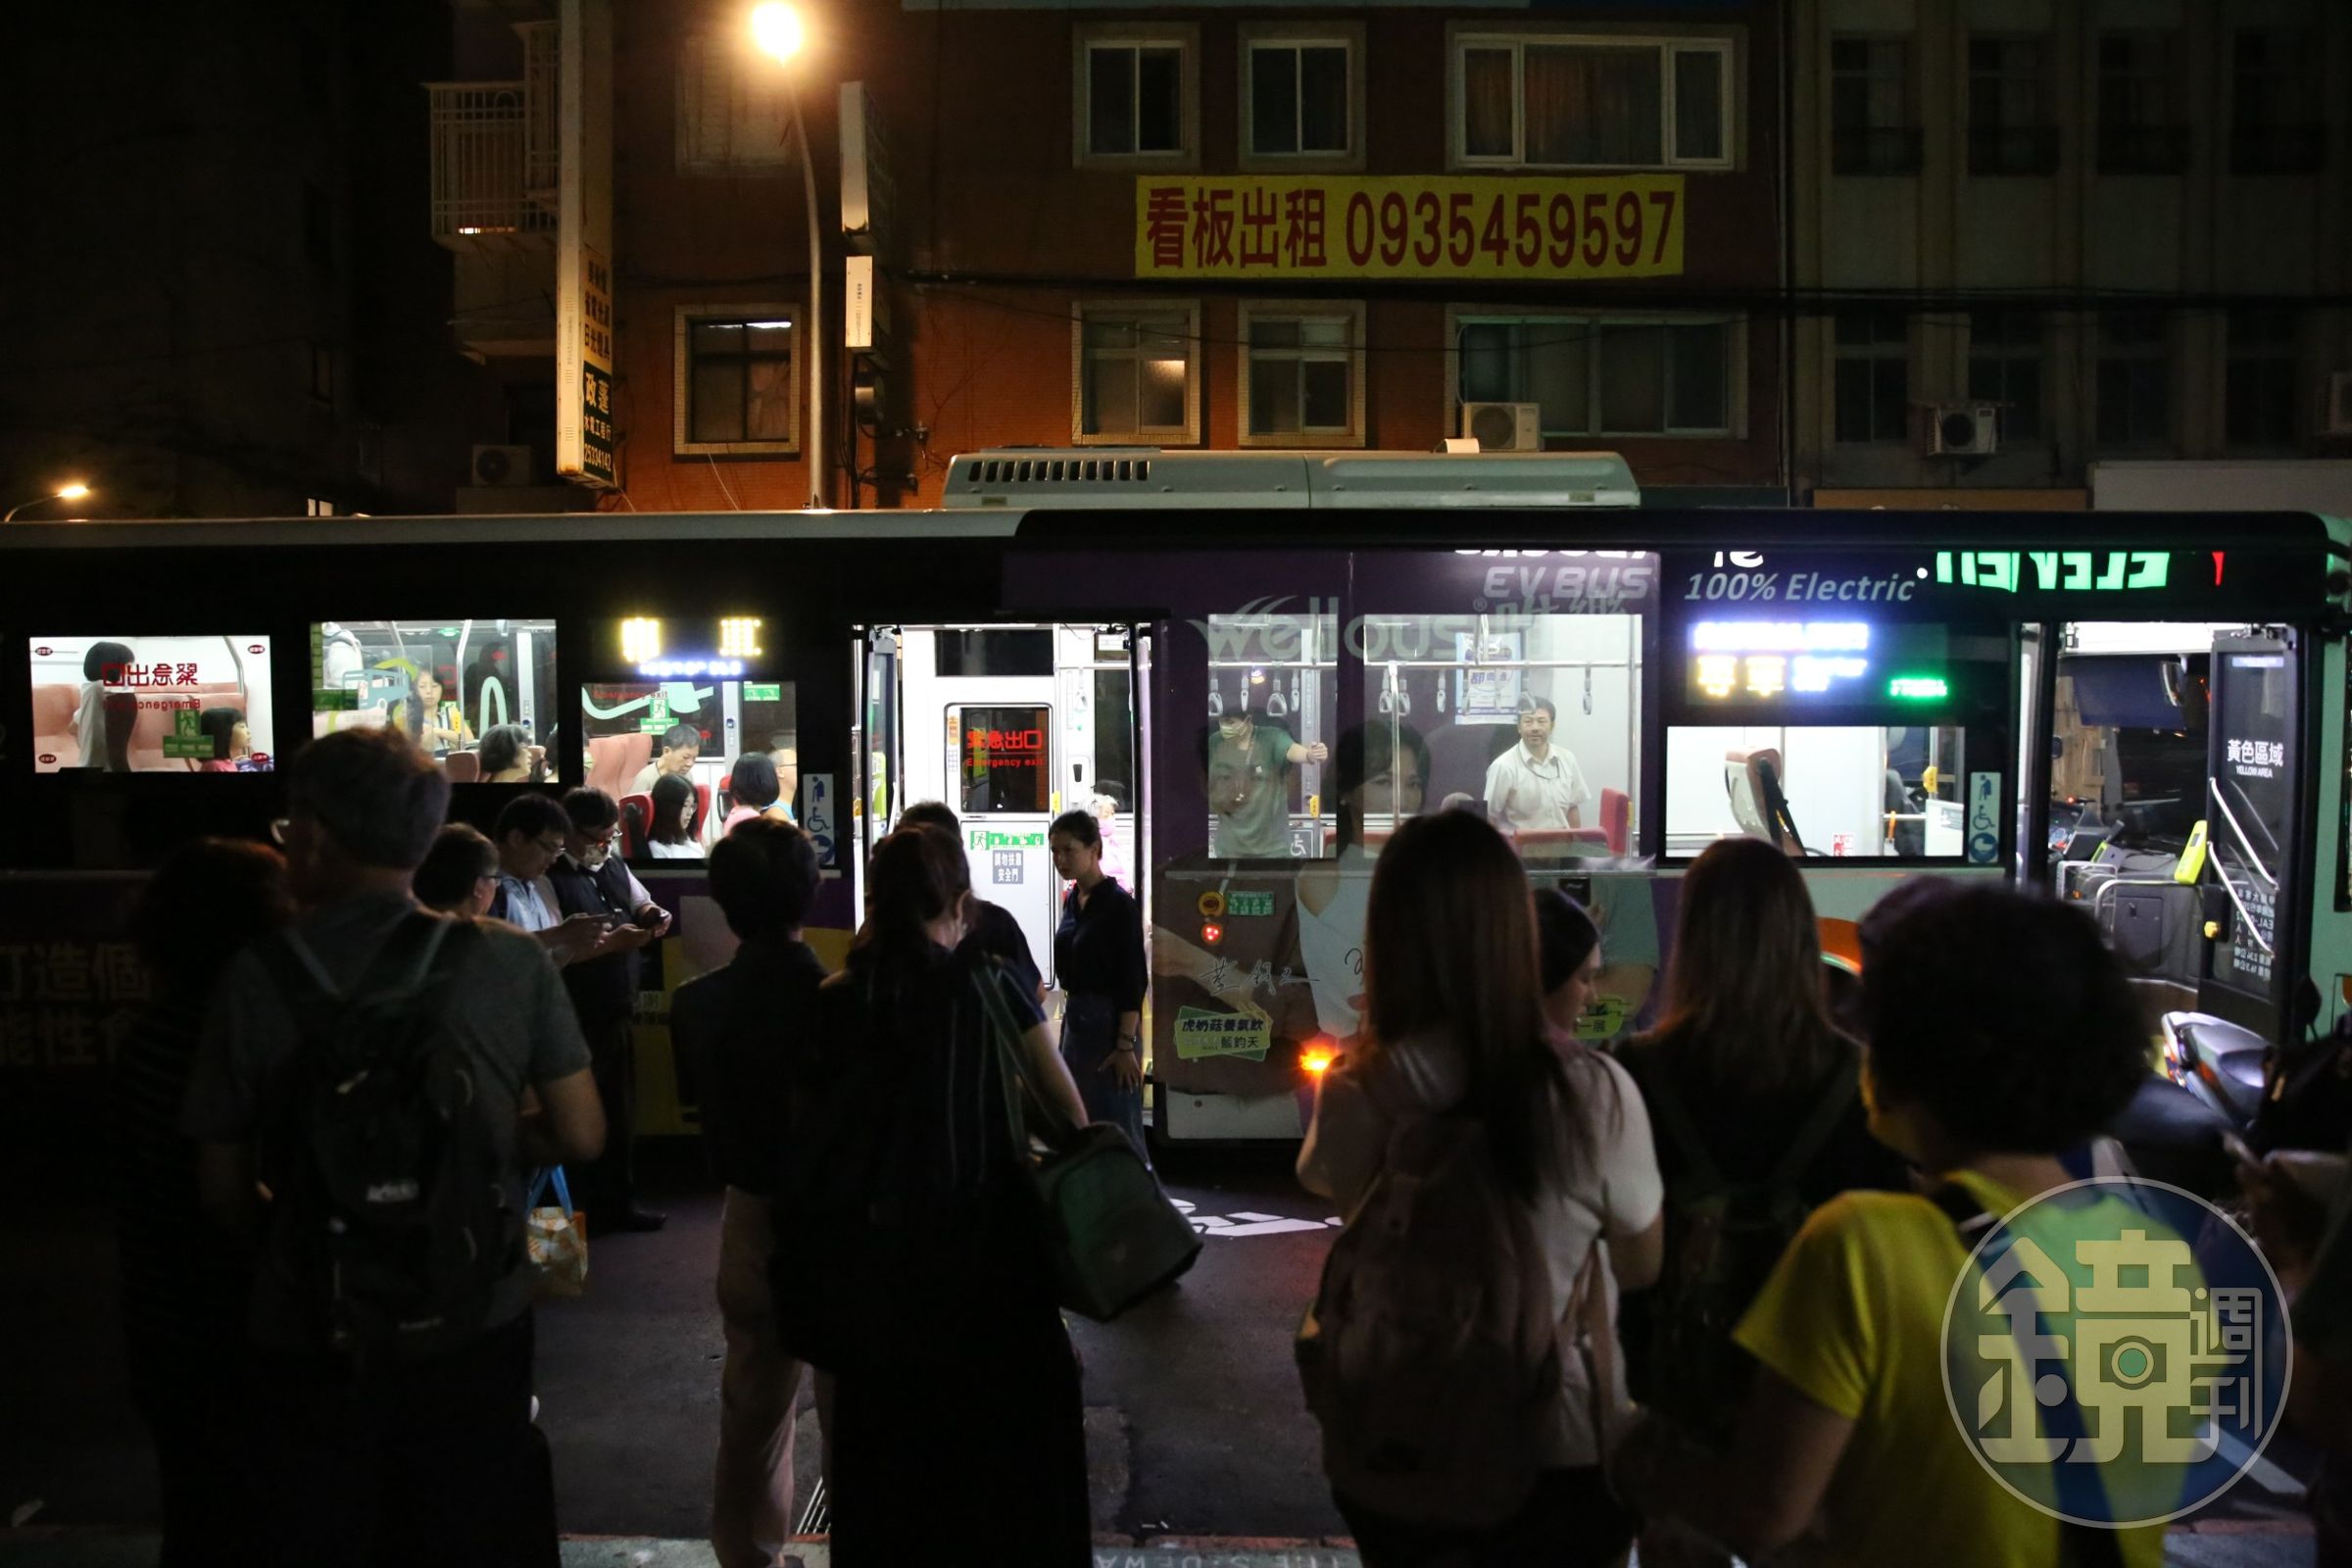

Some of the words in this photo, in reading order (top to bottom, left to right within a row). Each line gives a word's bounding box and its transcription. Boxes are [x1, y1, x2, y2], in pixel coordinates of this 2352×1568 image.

[1146, 186, 1328, 270] 看板出租
[1346, 190, 1676, 268] 0935459597
[1483, 565, 1547, 599] EV
[1551, 566, 1653, 600] BUS
[1684, 572, 1779, 601] 100%
[1785, 571, 1916, 602] Electric
